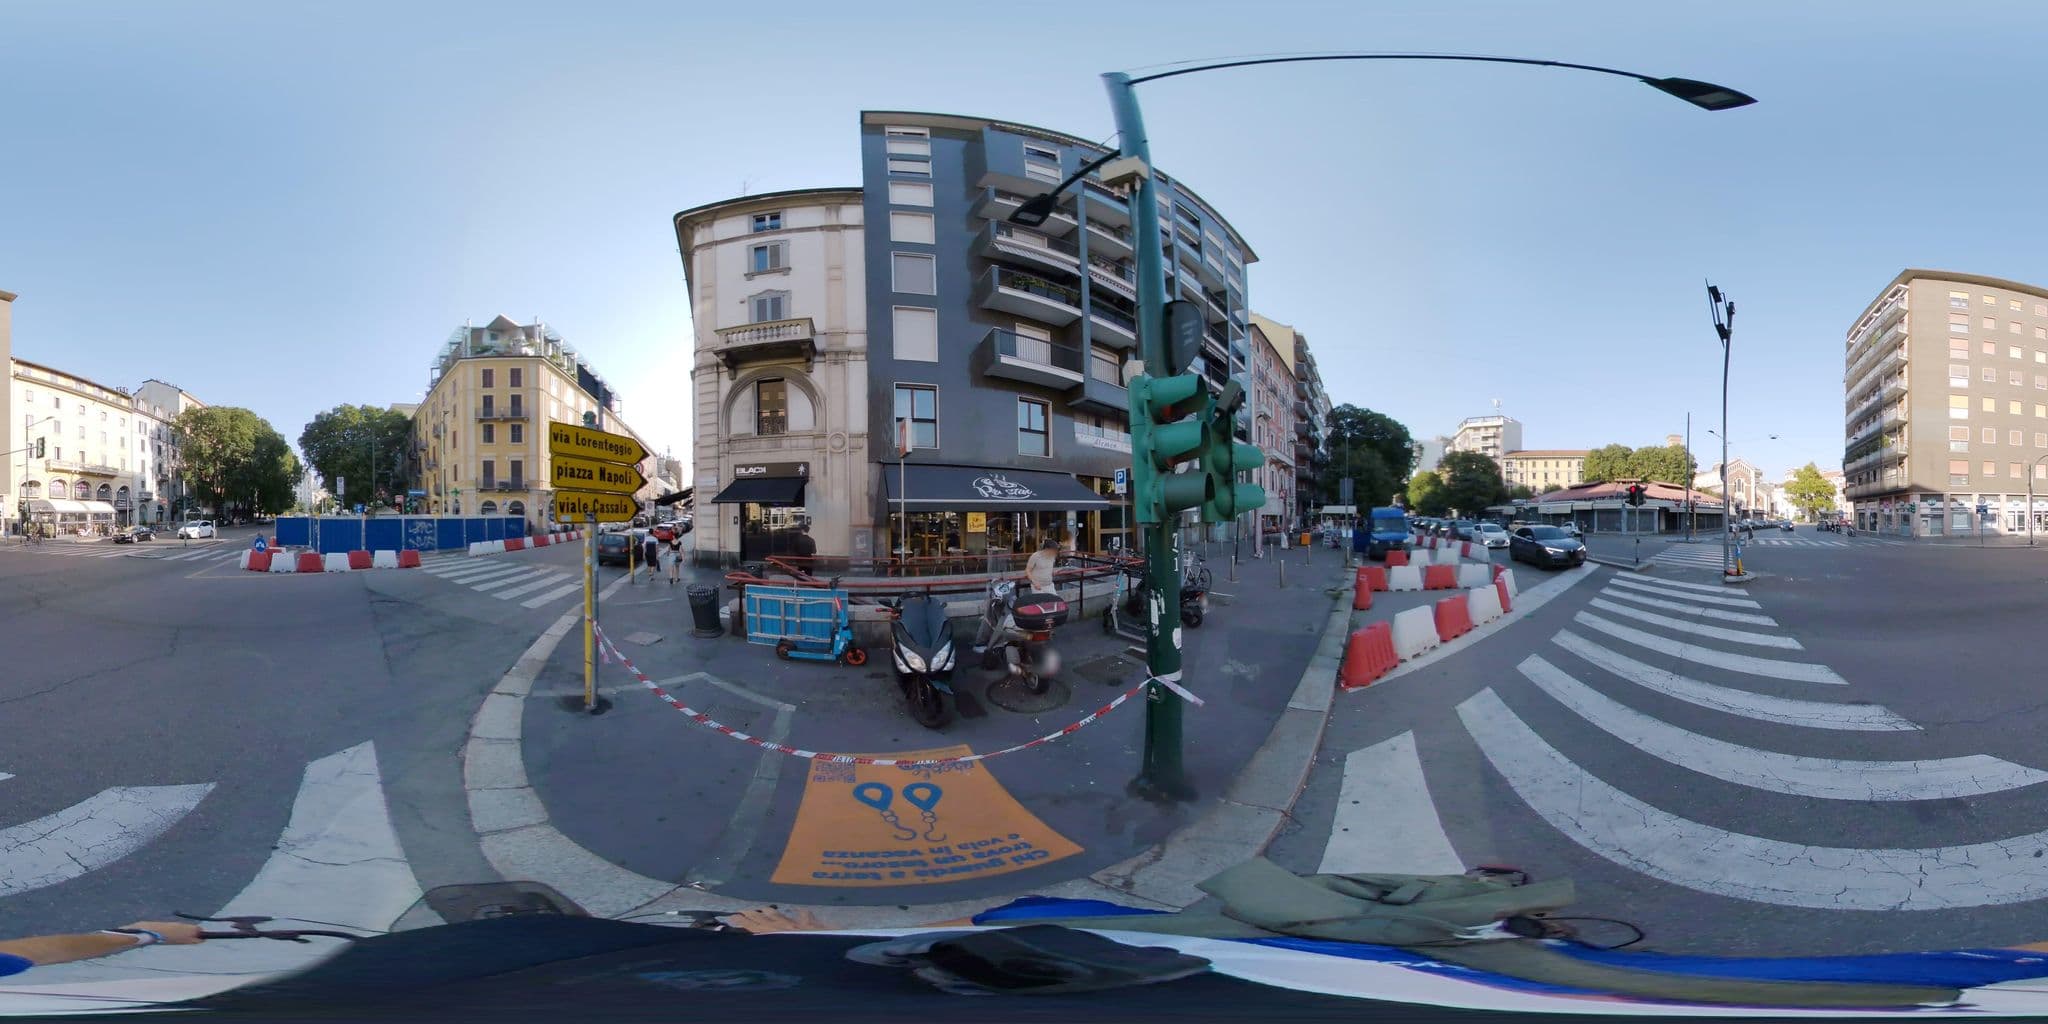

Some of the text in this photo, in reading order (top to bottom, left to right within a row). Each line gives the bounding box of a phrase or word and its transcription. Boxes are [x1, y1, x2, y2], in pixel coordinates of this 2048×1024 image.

[552, 429, 633, 457] via Lorenteggio
[556, 461, 632, 486] piazza Napoli
[558, 496, 628, 515] viale Cassala
[929, 845, 953, 856] in
[1010, 849, 1050, 865] Chi
